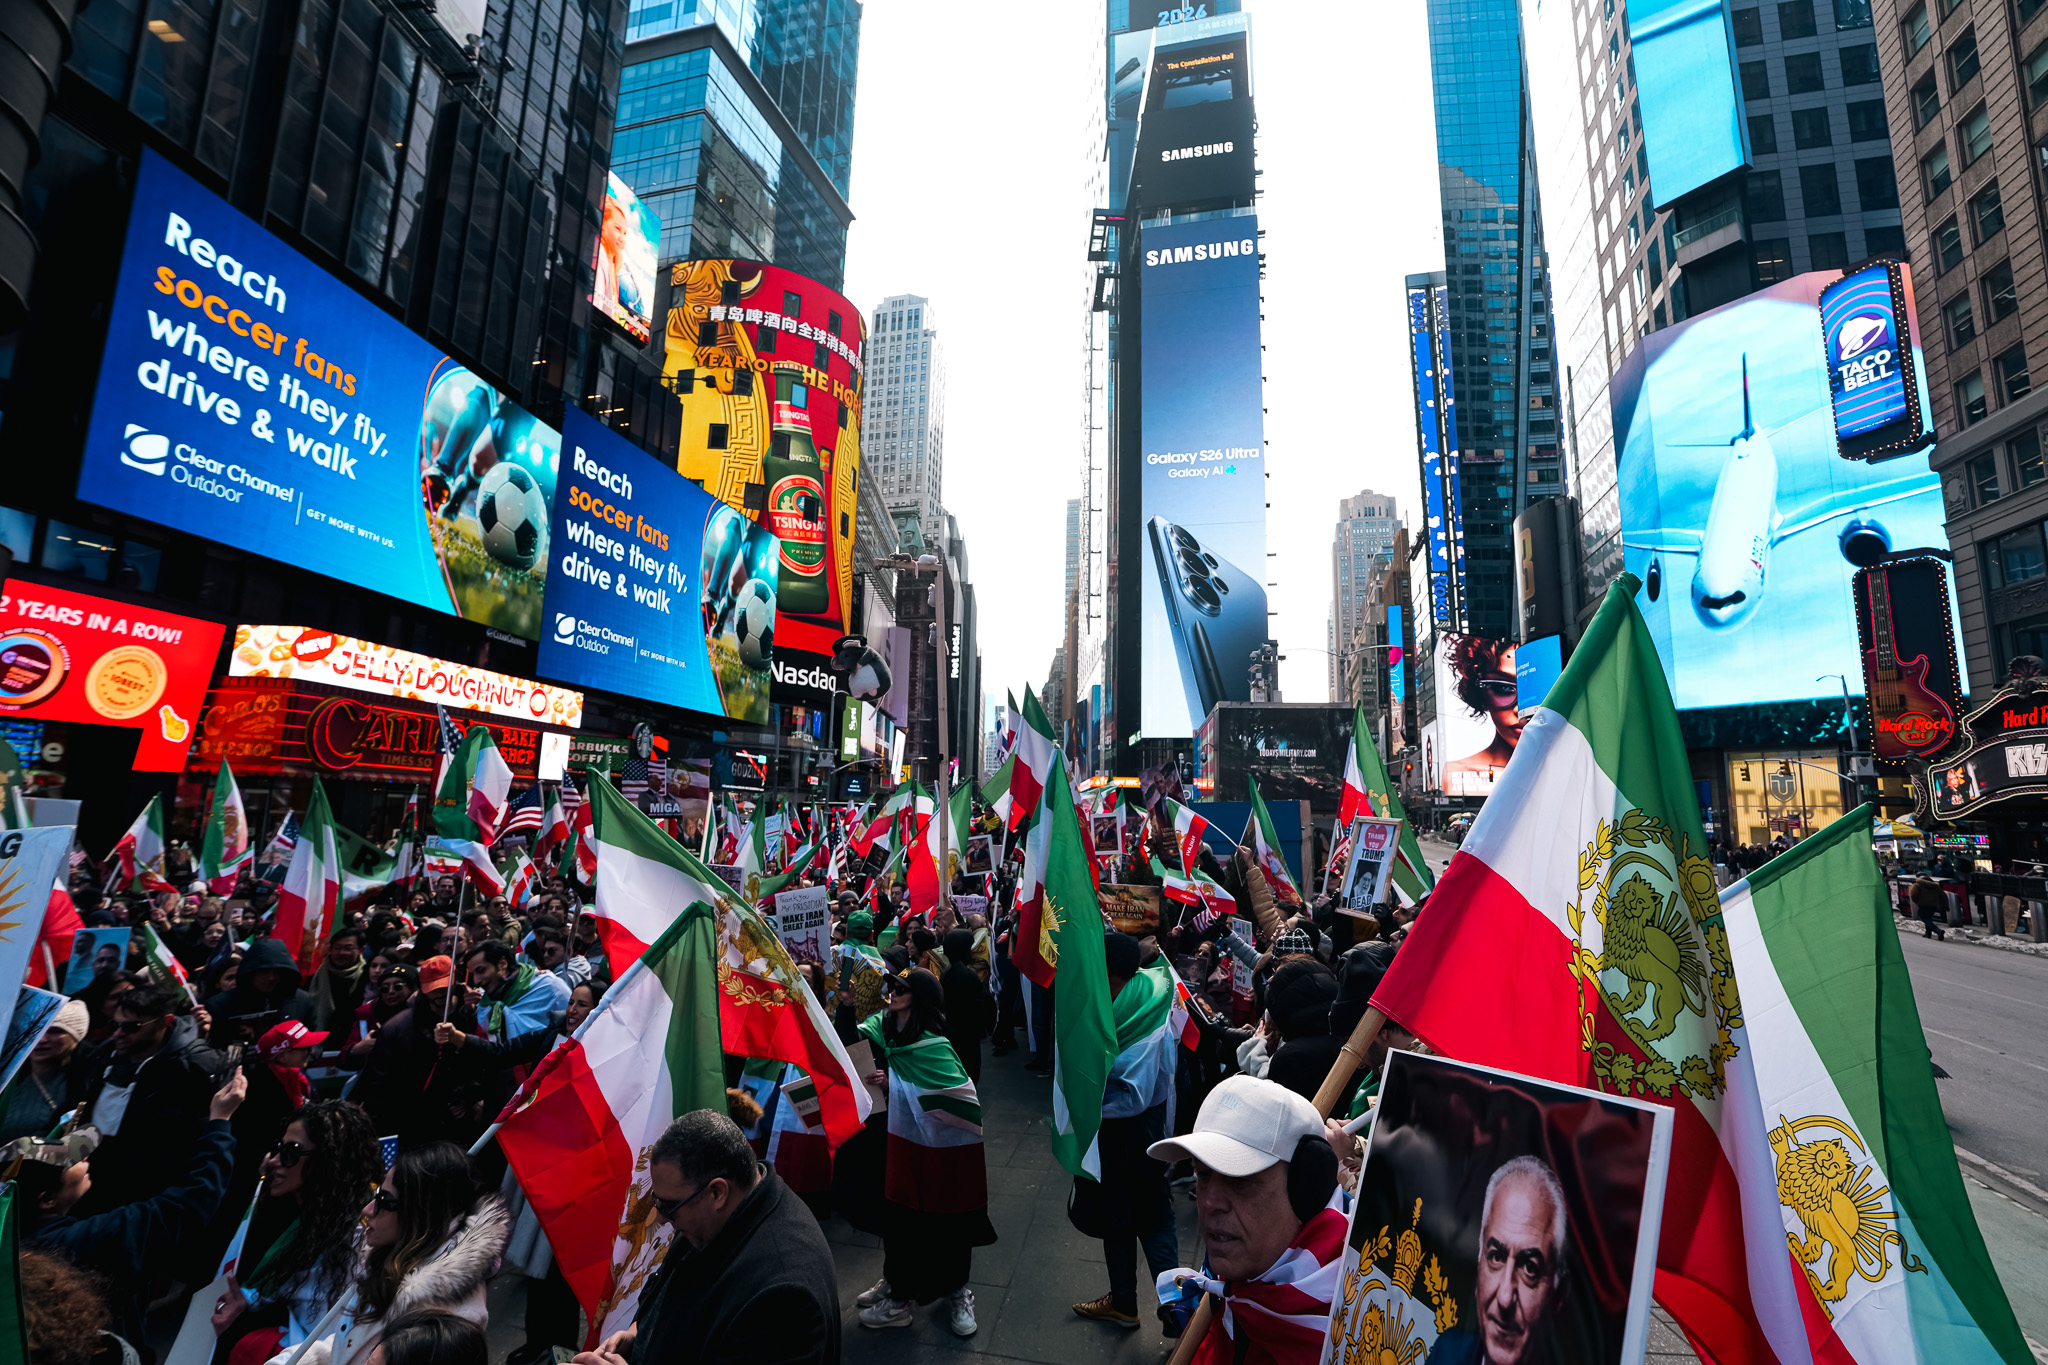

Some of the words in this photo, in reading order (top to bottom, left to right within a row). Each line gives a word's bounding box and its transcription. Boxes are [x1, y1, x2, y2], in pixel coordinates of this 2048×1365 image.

[1158, 4, 1207, 27] 2026
[1167, 62, 1179, 70] The
[1180, 56, 1220, 68] Constellation
[1162, 142, 1234, 162] SAMSUNG
[165, 212, 287, 313] Reach
[1146, 238, 1254, 267] SAMSUNG
[154, 265, 288, 357] soccer
[294, 338, 357, 396] fans
[695, 354, 747, 370] YEAR
[802, 364, 829, 392] HE
[1838, 350, 1891, 379] TACO
[147, 310, 270, 392] where
[280, 372, 348, 435] they
[354, 413, 389, 458] fly,
[1844, 364, 1894, 392] BELL
[137, 360, 241, 426] drive
[251, 408, 276, 445] &
[286, 425, 358, 481] walk
[1146, 452, 1198, 466] Galaxy
[1200, 450, 1224, 462] S26
[1225, 447, 1260, 460] Ultra
[174, 443, 224, 480] Clear
[227, 460, 294, 503] Channel
[574, 446, 632, 500] Reach
[1168, 467, 1210, 478] Galaxy
[1212, 466, 1224, 476] AI
[171, 465, 243, 504] Outdoor
[306, 507, 326, 523] GET
[328, 513, 355, 533] MORE
[358, 523, 380, 543] WITH
[381, 533, 396, 549] US.
[569, 486, 633, 534] soccer
[637, 515, 669, 551] fans
[566, 518, 625, 561] where
[629, 544, 665, 583] they
[668, 562, 688, 593] fly,
[562, 552, 612, 590] drive
[616, 572, 628, 598] &
[633, 582, 671, 615] walk
[1434, 576, 1448, 620] ROKU
[17, 598, 84, 626] YEARS
[86, 612, 111, 631] IN
[112, 618, 128, 635] A
[130, 623, 182, 645] ROW!
[576, 636, 609, 655] Outdoor
[578, 620, 601, 640] Clear
[602, 627, 634, 648] Channel
[296, 636, 332, 656] NEW
[640, 648, 650, 657] GET
[651, 652, 665, 662] MORE
[666, 656, 678, 665] WITH
[332, 650, 409, 686] JELLY
[416, 668, 526, 708] DOUGHNUT
[771, 660, 836, 693] Nasdaq
[1879, 718, 1914, 732] Hard
[1915, 717, 1950, 732] Rock
[2003, 706, 2038, 728] Hard
[501, 729, 537, 748] BAKE
[1904, 732, 1926, 740] CAFE
[381, 753, 414, 766] TIMES
[500, 747, 534, 764] SHOP
[650, 803, 680, 812] MIGA
[1368, 832, 1385, 840] THANK
[1362, 848, 1384, 860] TRUMP
[1127, 905, 1144, 913] IRAN
[1351, 894, 1372, 910] DEAD
[782, 913, 804, 924] MAKE
[806, 910, 824, 920] IRAN
[782, 922, 803, 932] GREAT
[805, 919, 824, 928] AGAIN
